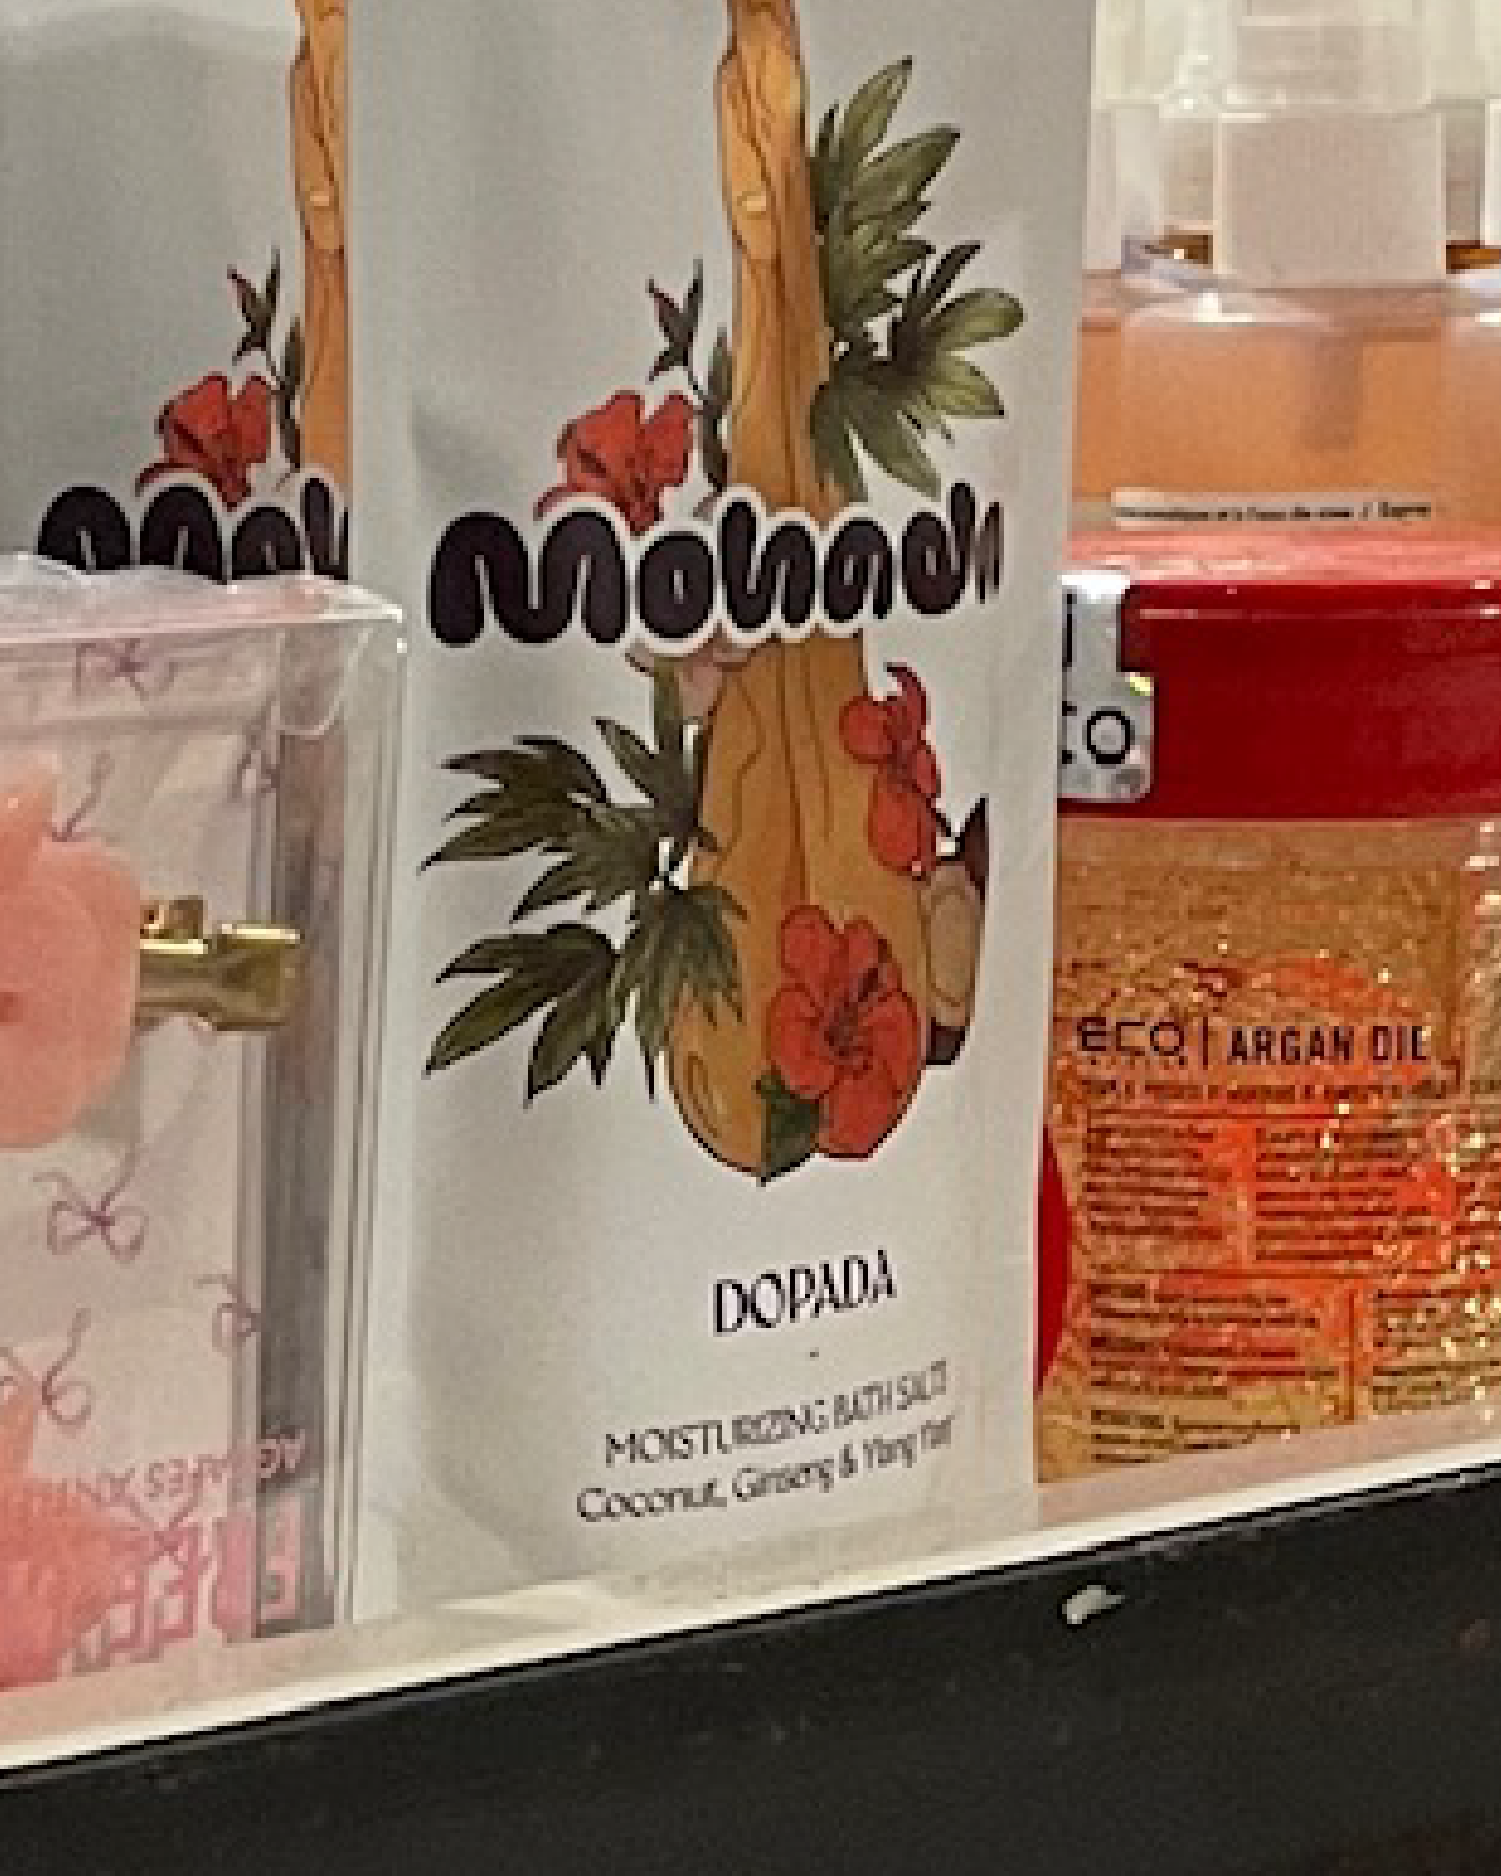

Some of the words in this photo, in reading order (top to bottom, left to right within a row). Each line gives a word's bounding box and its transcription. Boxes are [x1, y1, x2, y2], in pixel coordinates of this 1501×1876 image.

[1226, 1023, 1353, 1064] ARGAN
[712, 1248, 897, 1337] DOPADA
[604, 1398, 831, 1468] MOISTURIZING
[833, 1379, 894, 1428] BATH
